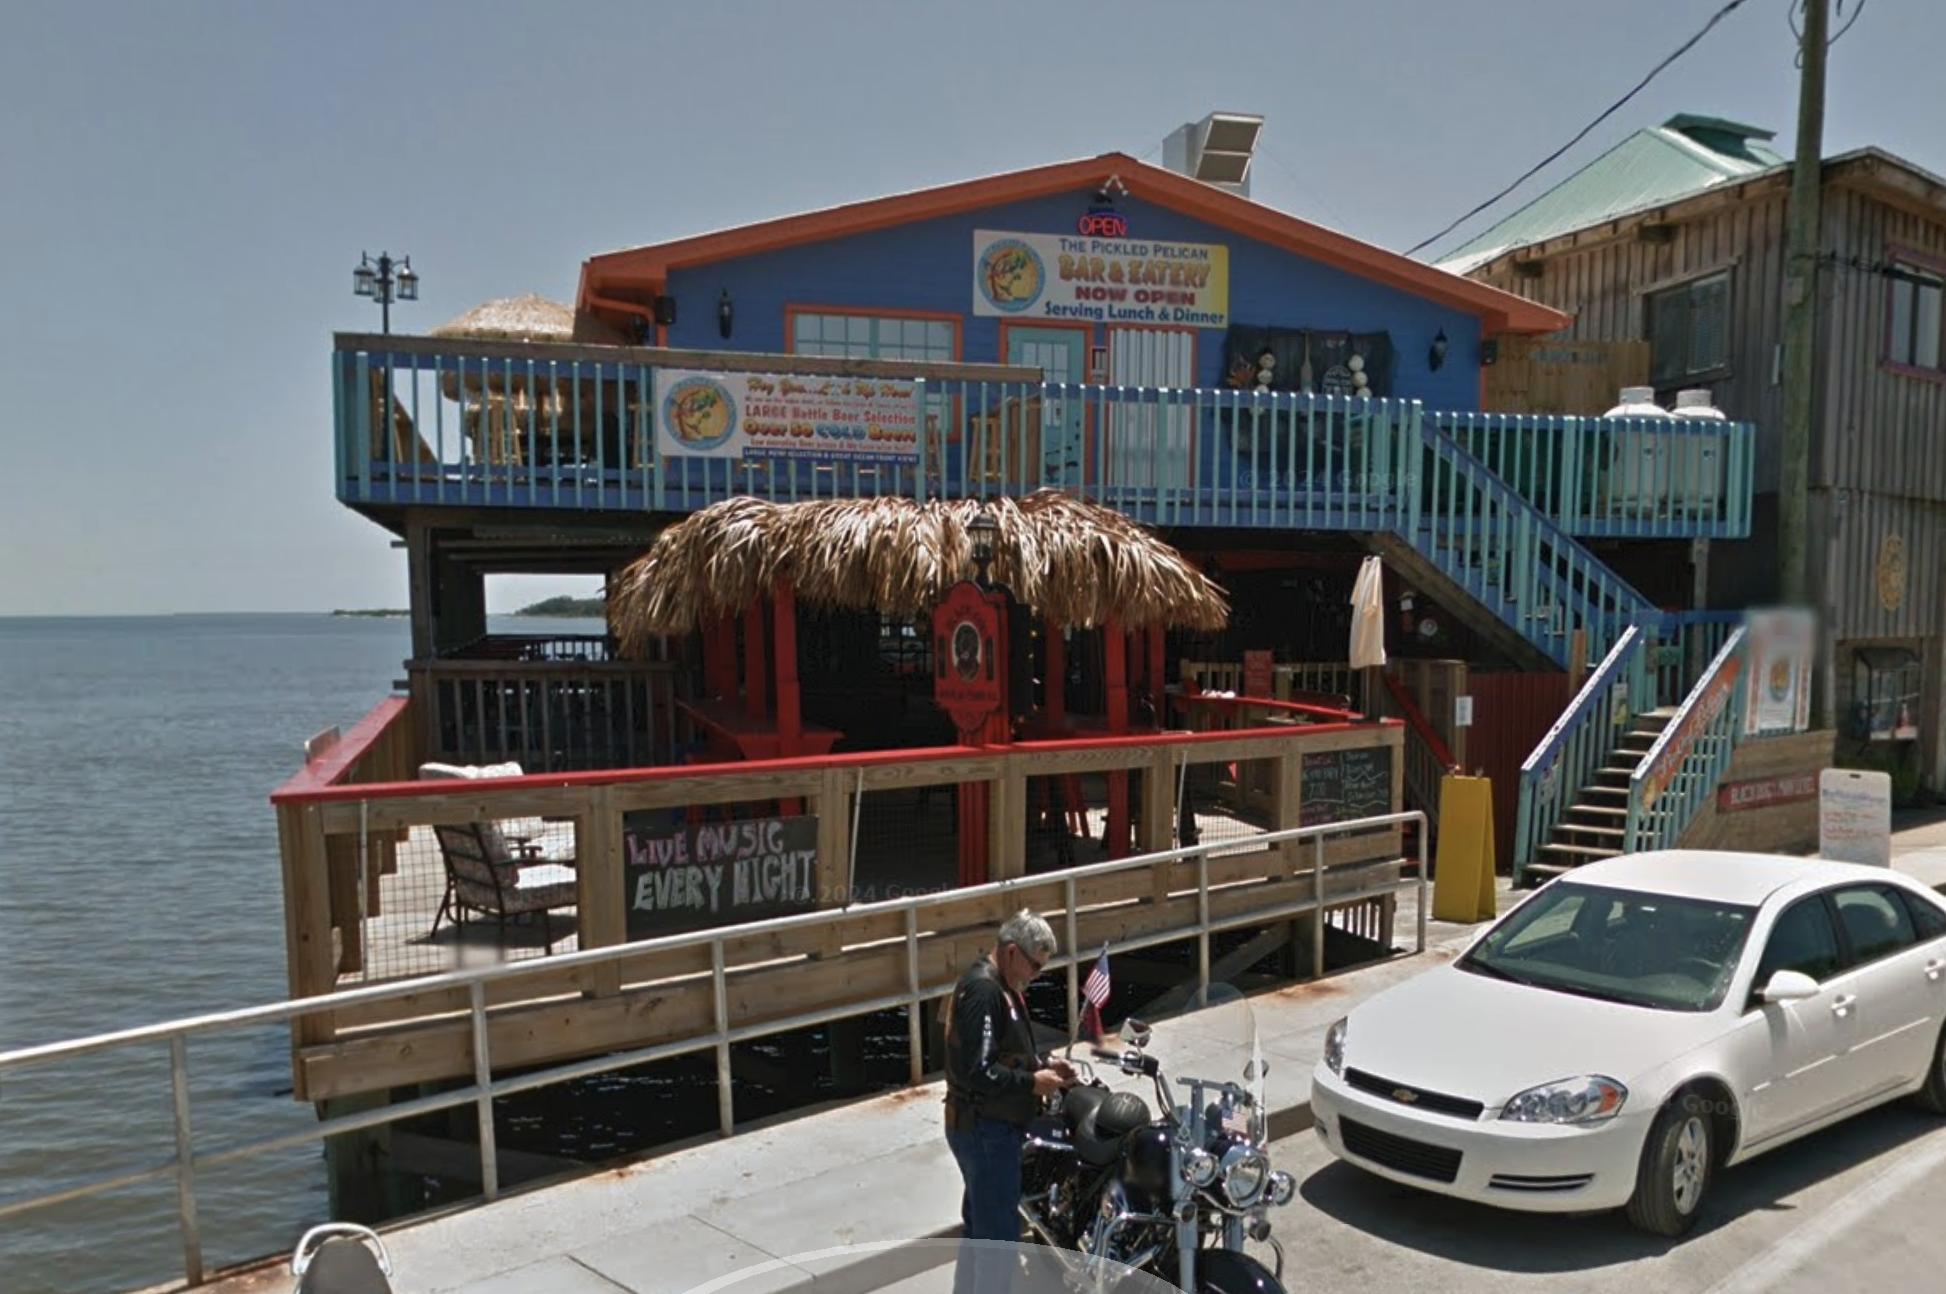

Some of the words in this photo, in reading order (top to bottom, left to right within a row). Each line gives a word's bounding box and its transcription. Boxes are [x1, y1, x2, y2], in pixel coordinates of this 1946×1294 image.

[1078, 215, 1127, 237] OPEN
[1059, 238, 1086, 253] THE
[1091, 239, 1148, 257] PICKLED
[1153, 244, 1208, 259] PELICAN
[1059, 255, 1105, 283] BAR
[1108, 260, 1125, 284] &
[1127, 258, 1211, 289] EATERY
[1075, 286, 1127, 301] NOW
[1134, 289, 1195, 306] OPEN
[1044, 301, 1103, 320] Serving
[1108, 303, 1154, 321] Lunch
[1158, 308, 1169, 322] &
[1173, 309, 1224, 325] Dinner
[745, 404, 788, 418] LARGE
[863, 410, 916, 425] Selection
[626, 831, 687, 868] LIVE
[696, 821, 784, 861] MUSIC
[632, 863, 724, 913] EVERY
[733, 850, 817, 906] NIGHT
